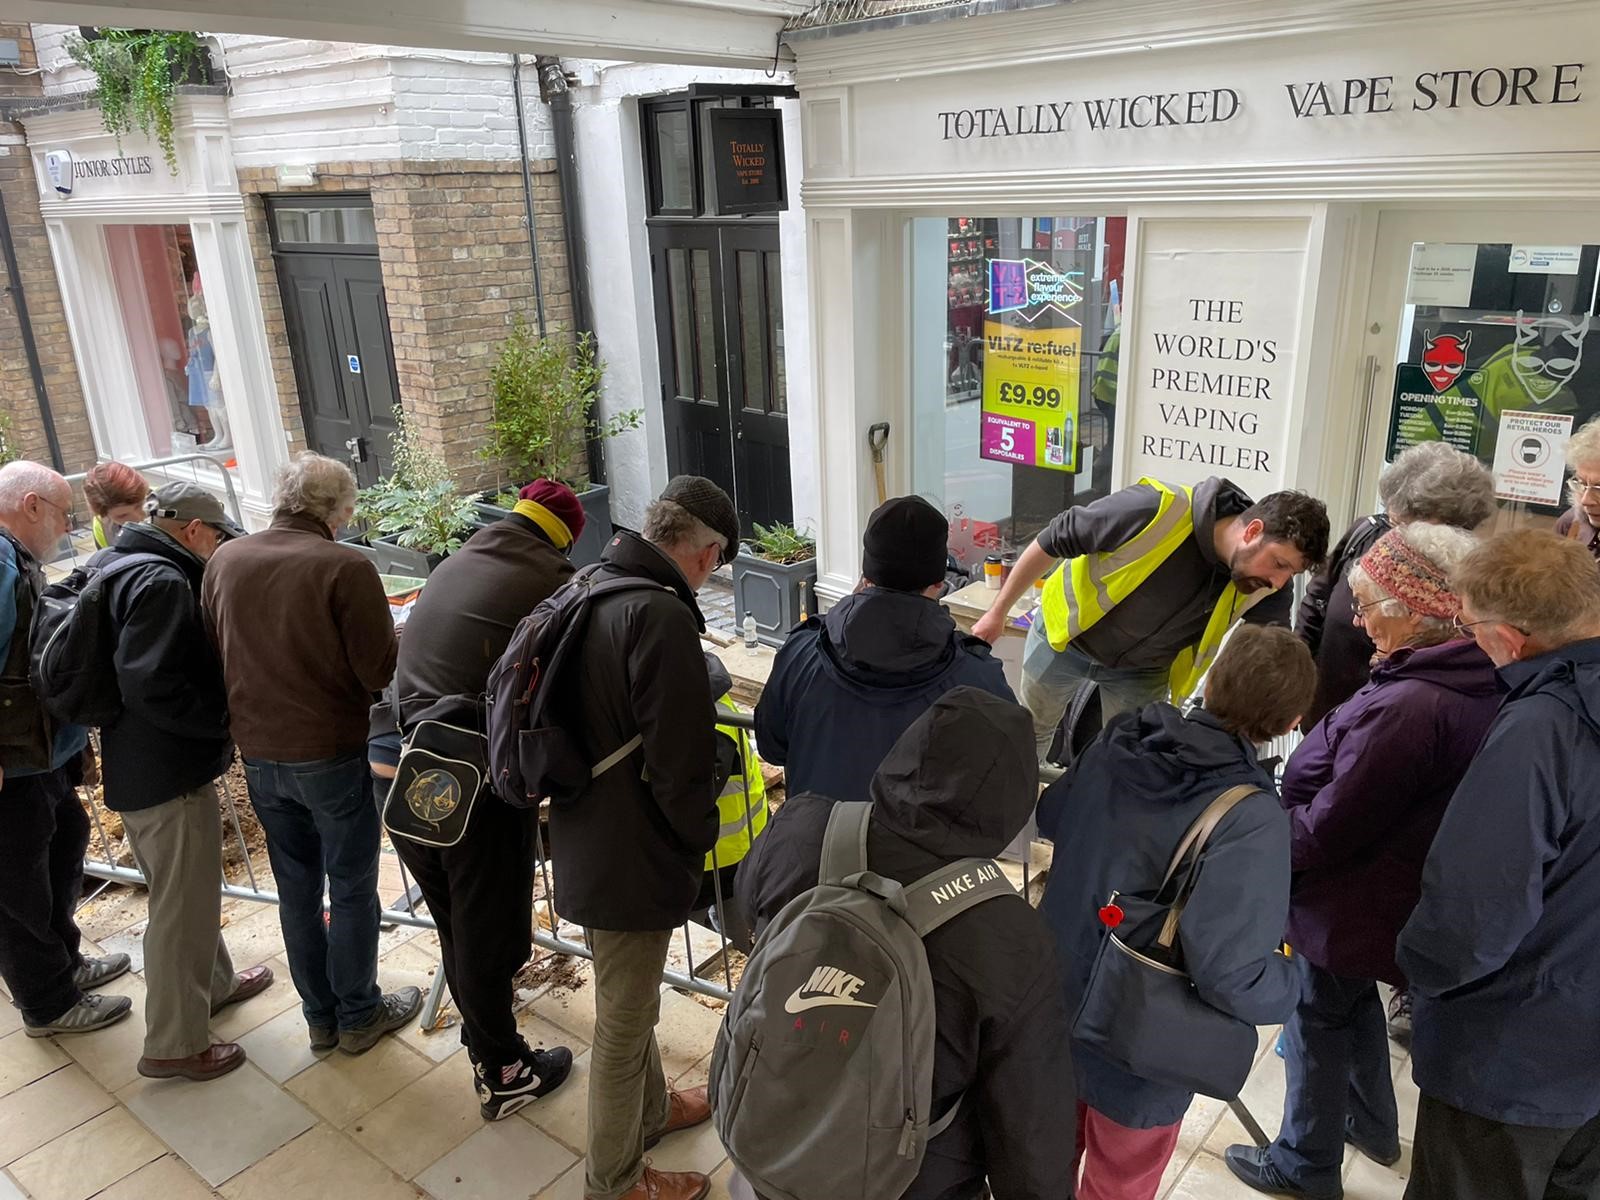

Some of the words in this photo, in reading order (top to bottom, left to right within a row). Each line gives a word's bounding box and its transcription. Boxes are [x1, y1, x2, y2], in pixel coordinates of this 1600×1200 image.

[938, 101, 1073, 140] TOTALLY
[1082, 88, 1241, 131] WICKED
[1285, 75, 1394, 118] VAPE
[1412, 63, 1584, 111] STORE
[74, 159, 111, 178] JUNIOR
[111, 156, 152, 176] STYLES
[1030, 273, 1066, 283] extreme
[1033, 282, 1064, 292] flavour
[1189, 299, 1244, 324] THE
[988, 335, 1023, 353] VLTZ
[1028, 341, 1077, 357] re:fuel
[1154, 333, 1277, 363] WORLD'S
[999, 382, 1061, 408] £9.99
[1151, 368, 1272, 400] PREMIER
[1400, 392, 1446, 404] OPENING
[1446, 396, 1478, 407] TIMES
[988, 417, 1021, 428] EQUIVALENT
[1022, 422, 1030, 430] TO
[1158, 403, 1259, 435] VAPING
[1507, 424, 1531, 432] RETAIL
[1532, 427, 1562, 435] HEROES
[1510, 418, 1544, 426] PROTECT
[1544, 420, 1561, 428] OUR
[1000, 426, 1015, 451] 5
[989, 448, 1024, 460] DISPOSABLES
[1142, 435, 1271, 472] RETAILER
[931, 873, 975, 905] NIKE
[978, 864, 999, 884] AIR
[801, 966, 865, 1000] NIKE
